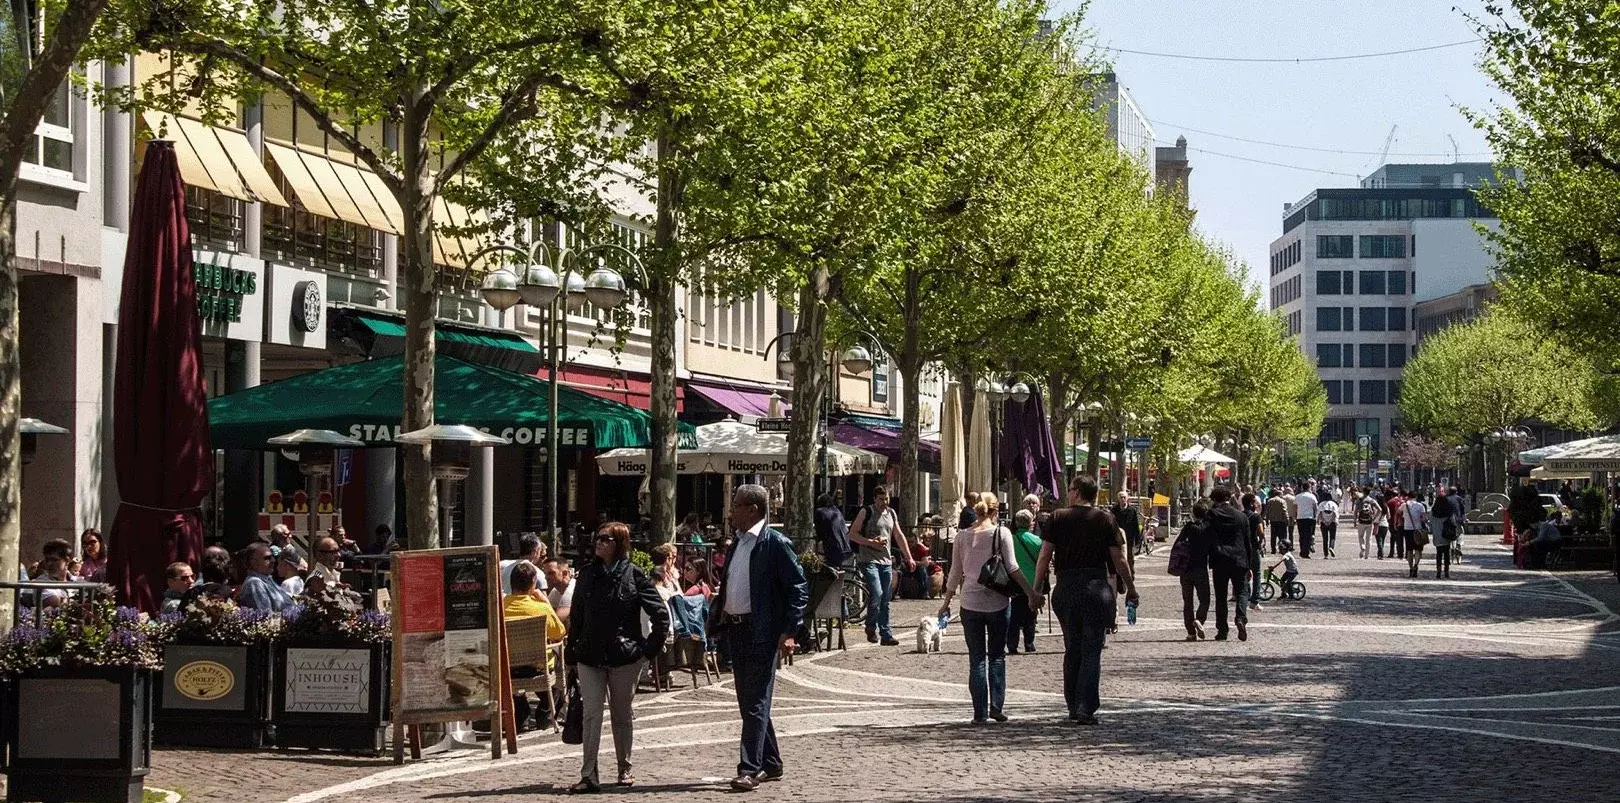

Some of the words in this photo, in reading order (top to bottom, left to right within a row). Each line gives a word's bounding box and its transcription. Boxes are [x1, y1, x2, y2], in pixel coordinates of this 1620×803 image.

[194, 262, 257, 295] ARBUCKS
[197, 295, 241, 323] OFFEE
[298, 673, 359, 684] INHOUSE
